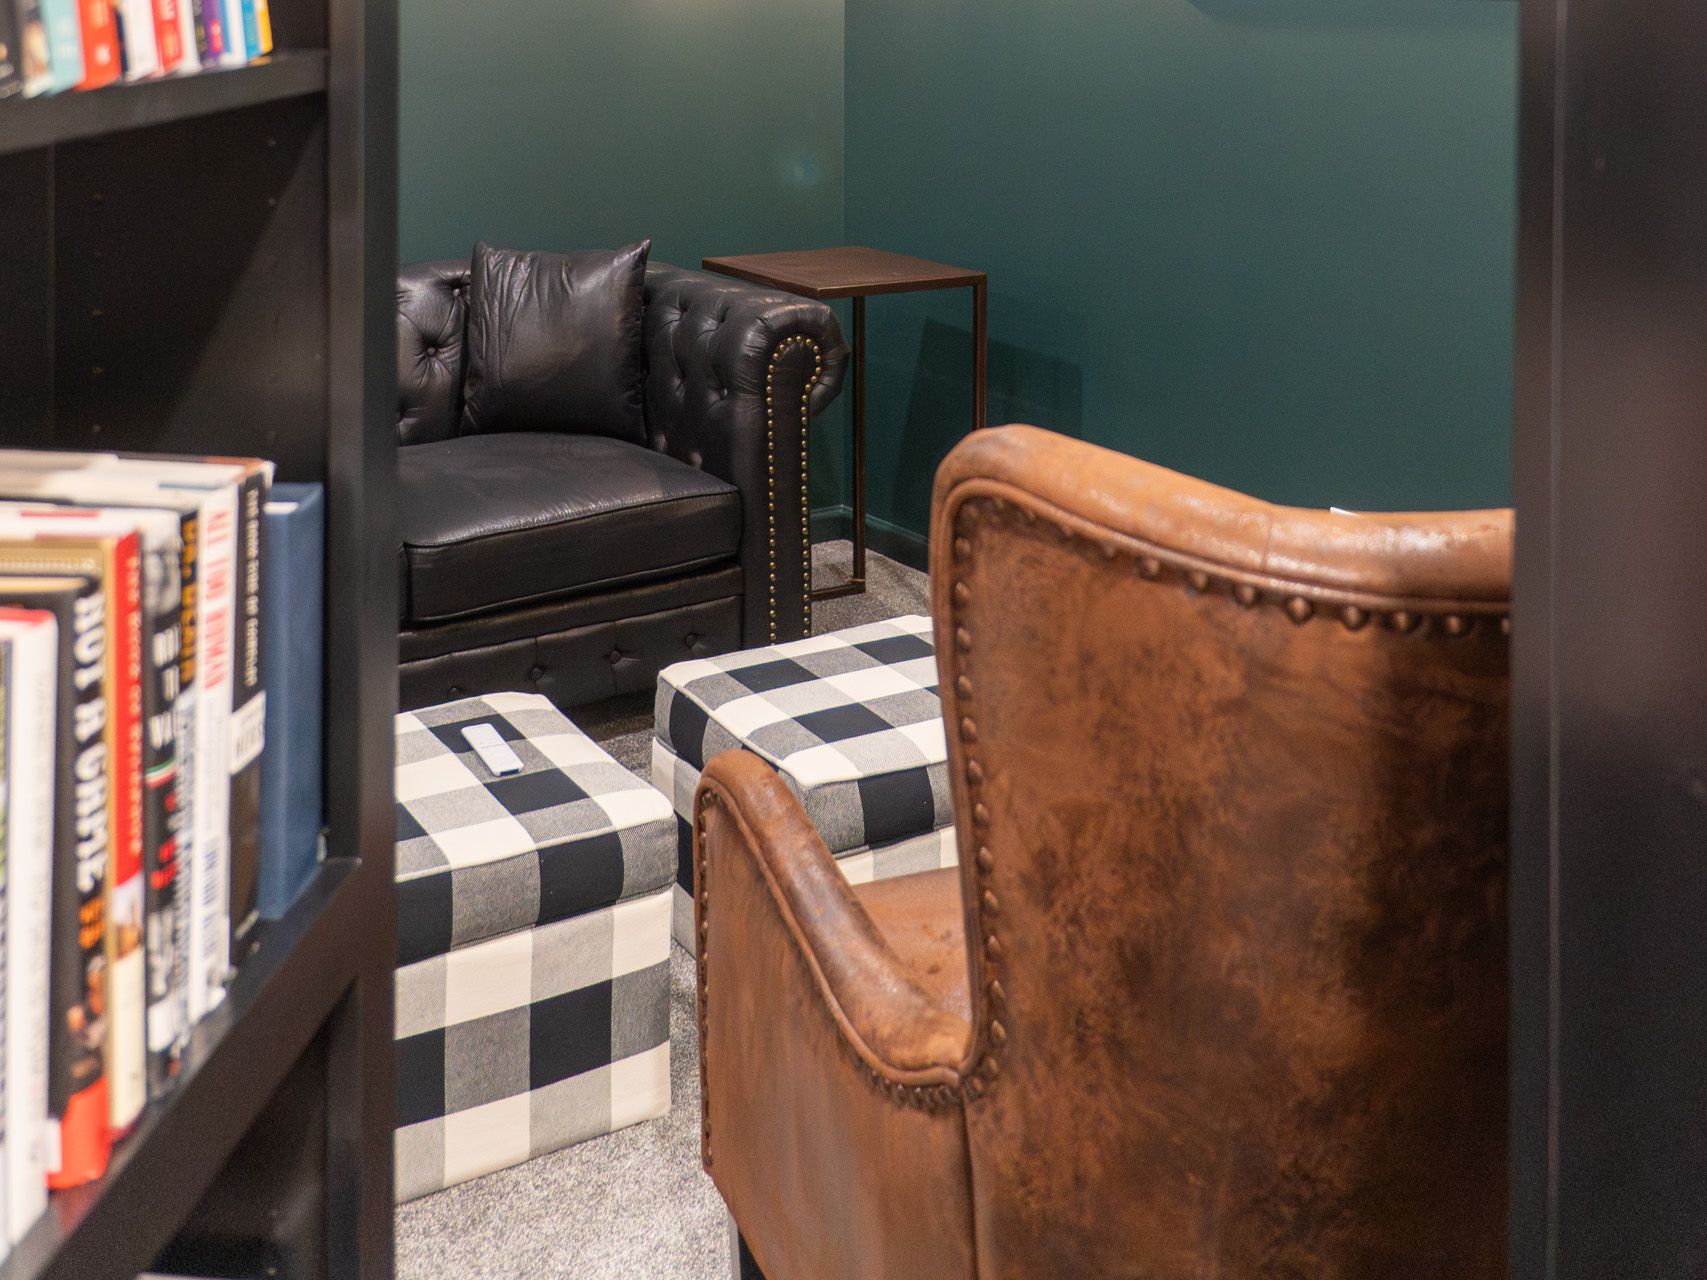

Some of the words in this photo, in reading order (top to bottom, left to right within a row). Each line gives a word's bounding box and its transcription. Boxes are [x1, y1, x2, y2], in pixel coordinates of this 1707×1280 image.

[73, 591, 107, 691] NOT
[73, 697, 107, 742] A
[74, 742, 108, 893] GAME
